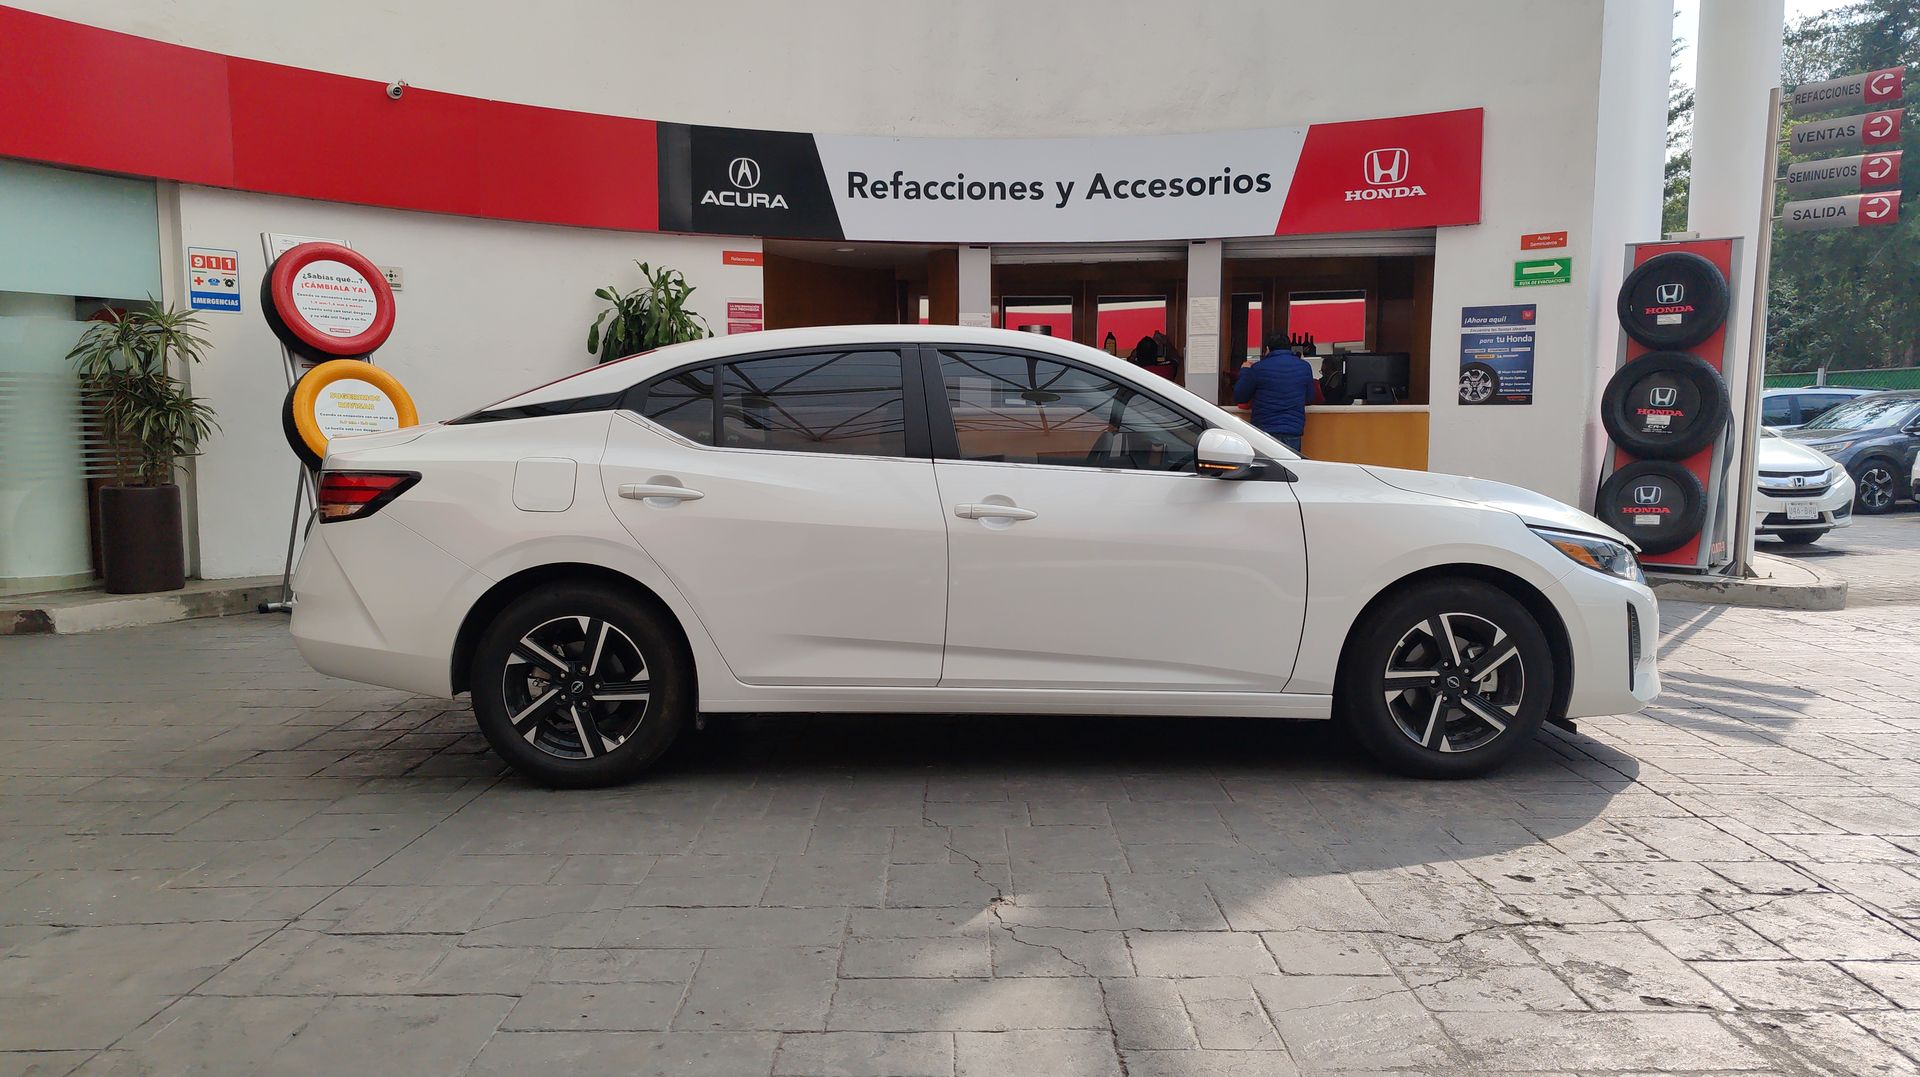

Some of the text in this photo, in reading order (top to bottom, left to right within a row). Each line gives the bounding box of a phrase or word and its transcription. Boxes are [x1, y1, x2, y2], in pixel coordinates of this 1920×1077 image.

[1794, 83, 1861, 104] REFACCIONES
[1797, 125, 1856, 143] VENTAS
[1789, 165, 1857, 183] SEMINUEVOS
[847, 166, 1272, 208] Refacciones y Accesorios
[1344, 184, 1427, 202] HONDA
[700, 190, 789, 210] ACURA
[1792, 205, 1847, 221] SALIDA
[194, 256, 232, 269] 911
[192, 297, 239, 306] EMERGENCIAS
[1644, 304, 1695, 315] HONDA
[1506, 334, 1533, 343] Honda
[1637, 408, 1684, 416] HONDA
[1621, 506, 1672, 514] HONDA
